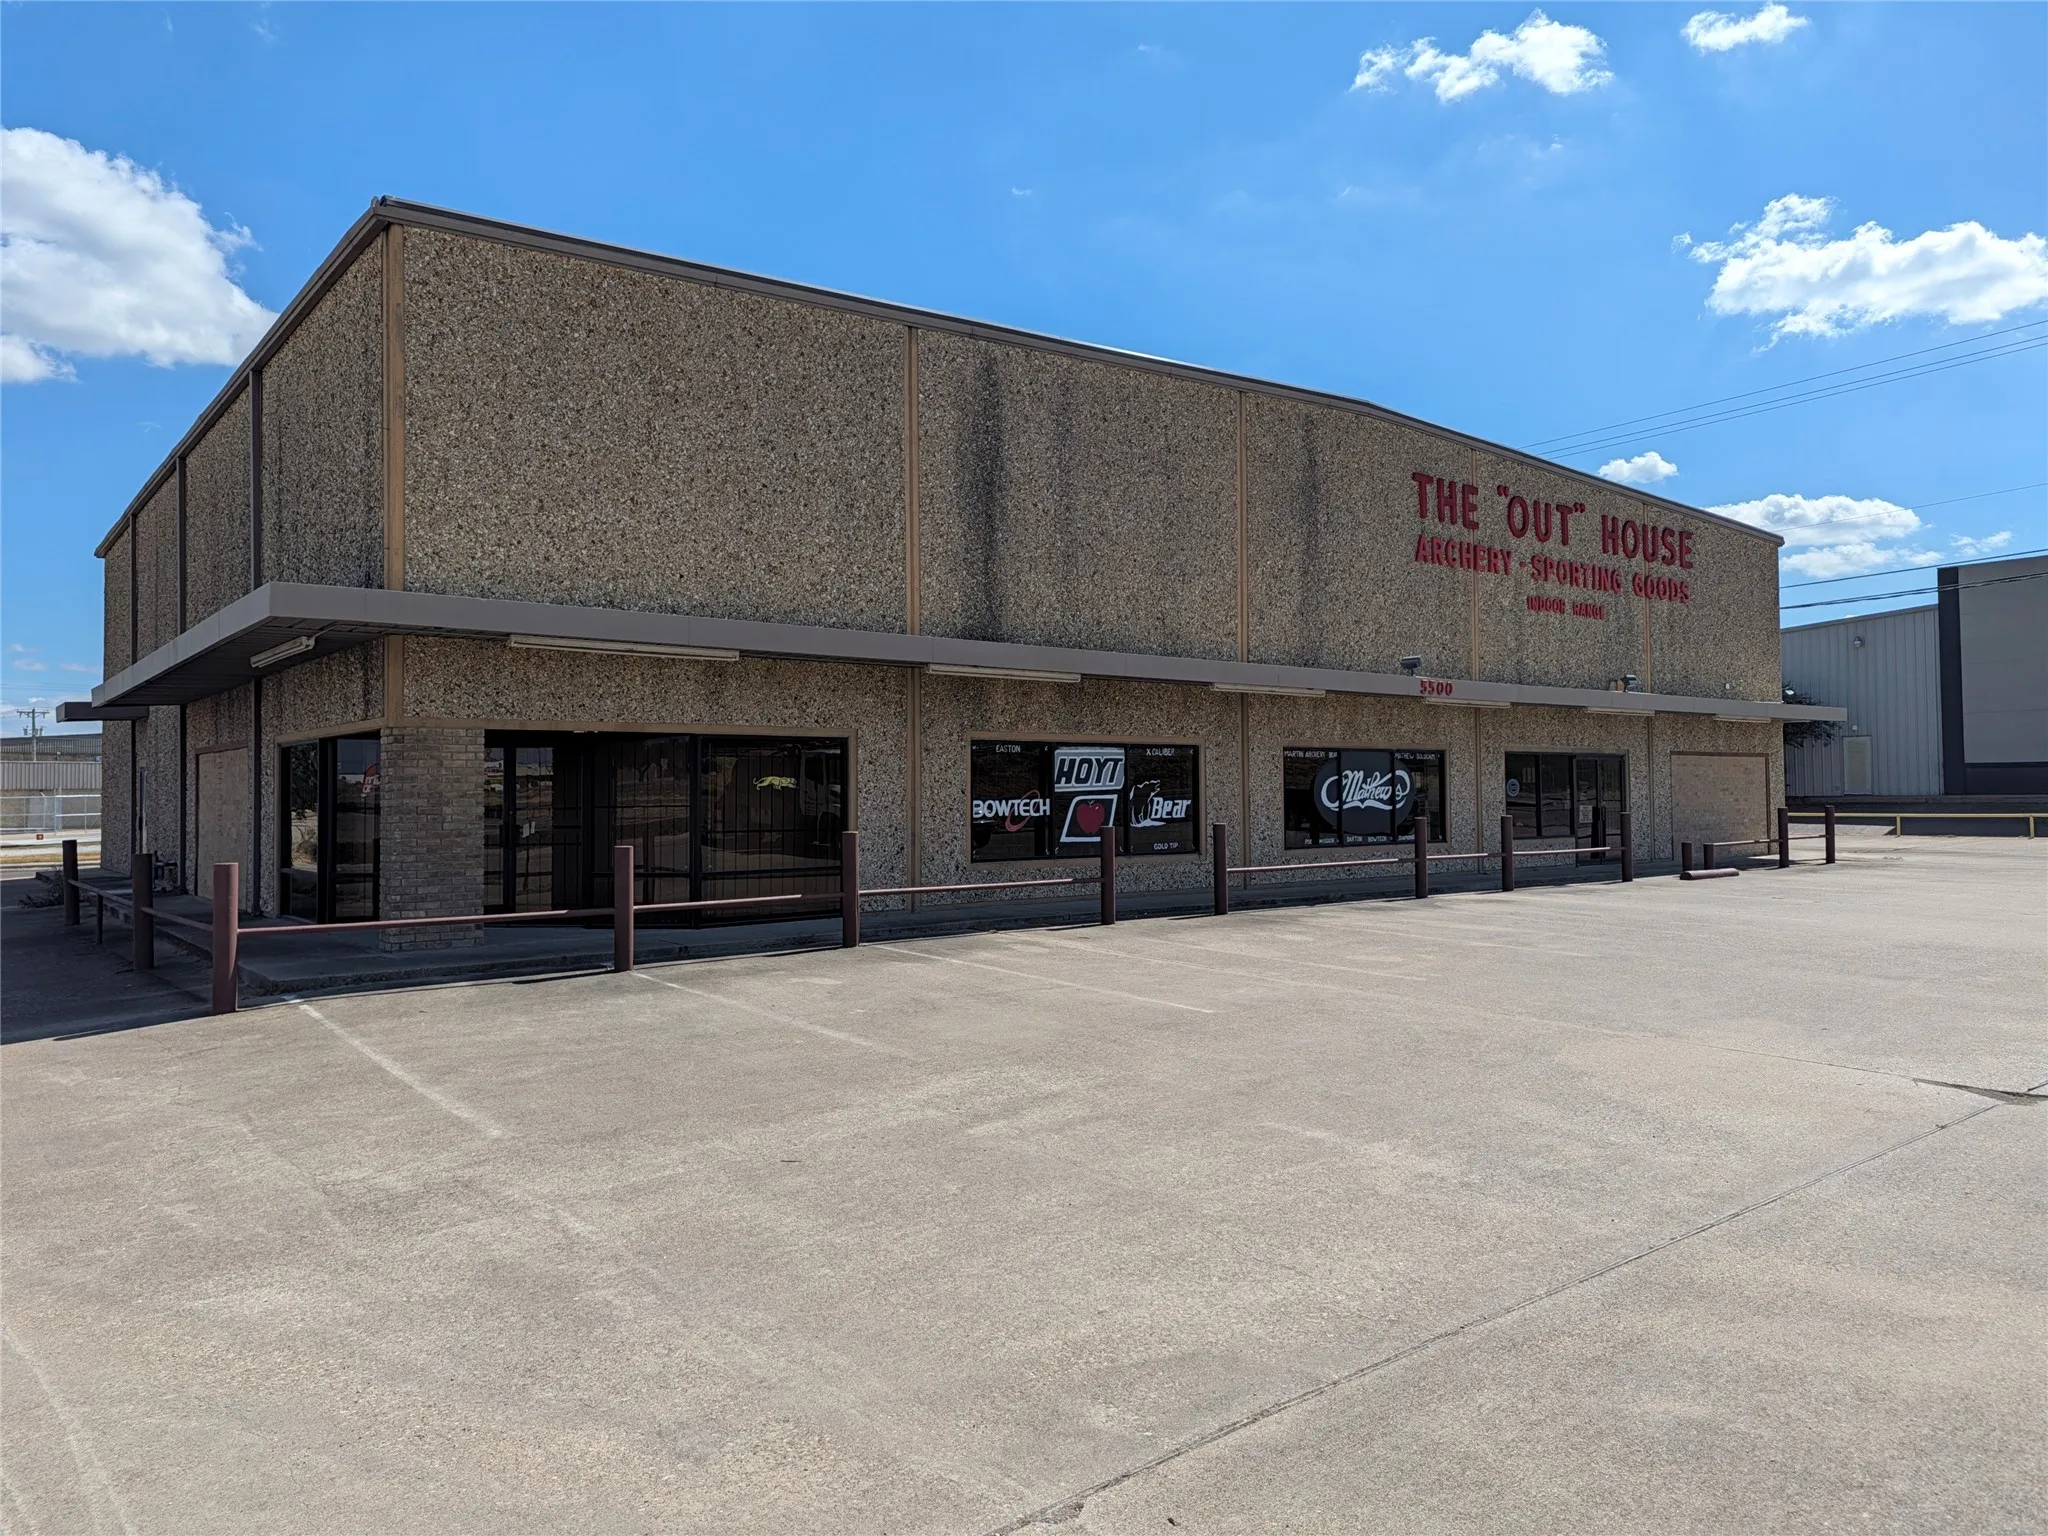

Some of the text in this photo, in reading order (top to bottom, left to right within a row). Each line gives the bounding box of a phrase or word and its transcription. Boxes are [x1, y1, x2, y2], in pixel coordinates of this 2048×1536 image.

[1412, 472, 1480, 531] THE
[1601, 514, 1695, 570] HOUSE
[1414, 533, 1691, 605] ARCHERY SPORTING GOODS
[1526, 595, 1566, 615] INDOOR
[1419, 679, 1454, 697] 5500
[995, 744, 1021, 753] EASTON
[1284, 750, 1304, 758] MARTIN
[1055, 756, 1125, 786] HOYT
[1342, 770, 1411, 802] Mathews
[973, 798, 1050, 818] BOWTECH
[1150, 797, 1192, 819] Bear
